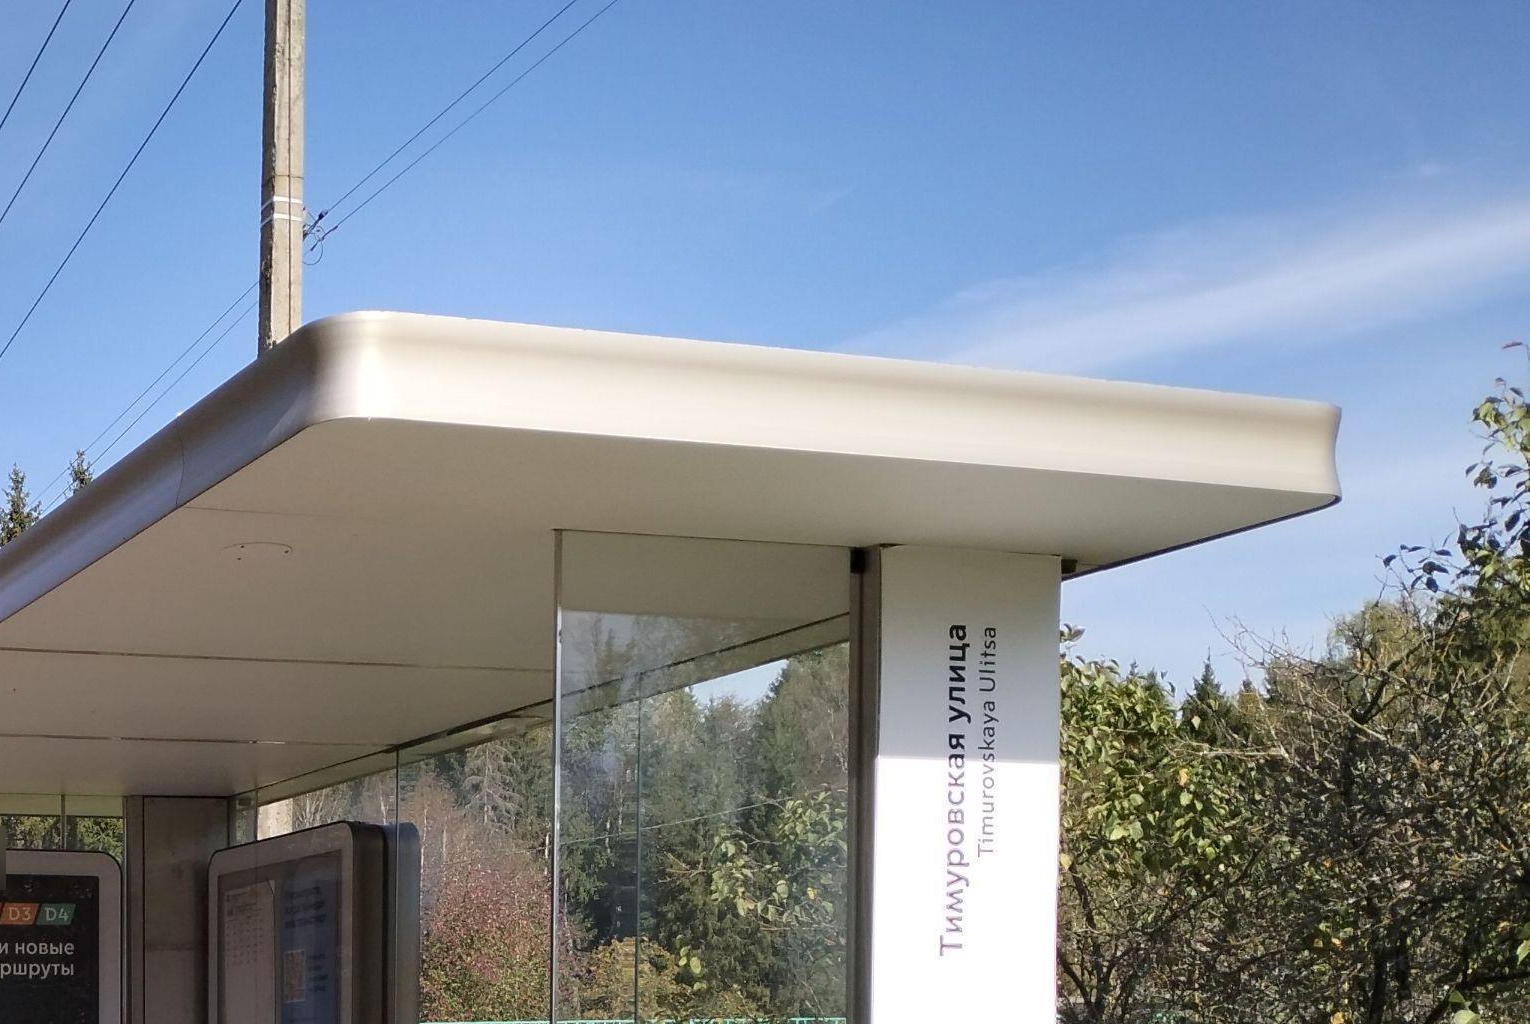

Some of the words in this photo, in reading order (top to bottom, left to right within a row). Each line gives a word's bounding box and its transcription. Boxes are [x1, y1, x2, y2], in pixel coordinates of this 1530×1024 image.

[948, 623, 972, 724] улица
[978, 625, 997, 693] Ulitsa
[977, 700, 1000, 858] Timurovskaya
[939, 733, 970, 956] Тимуровская
[8, 903, 32, 922] D3
[44, 904, 69, 922] D4
[15, 941, 75, 956] новые
